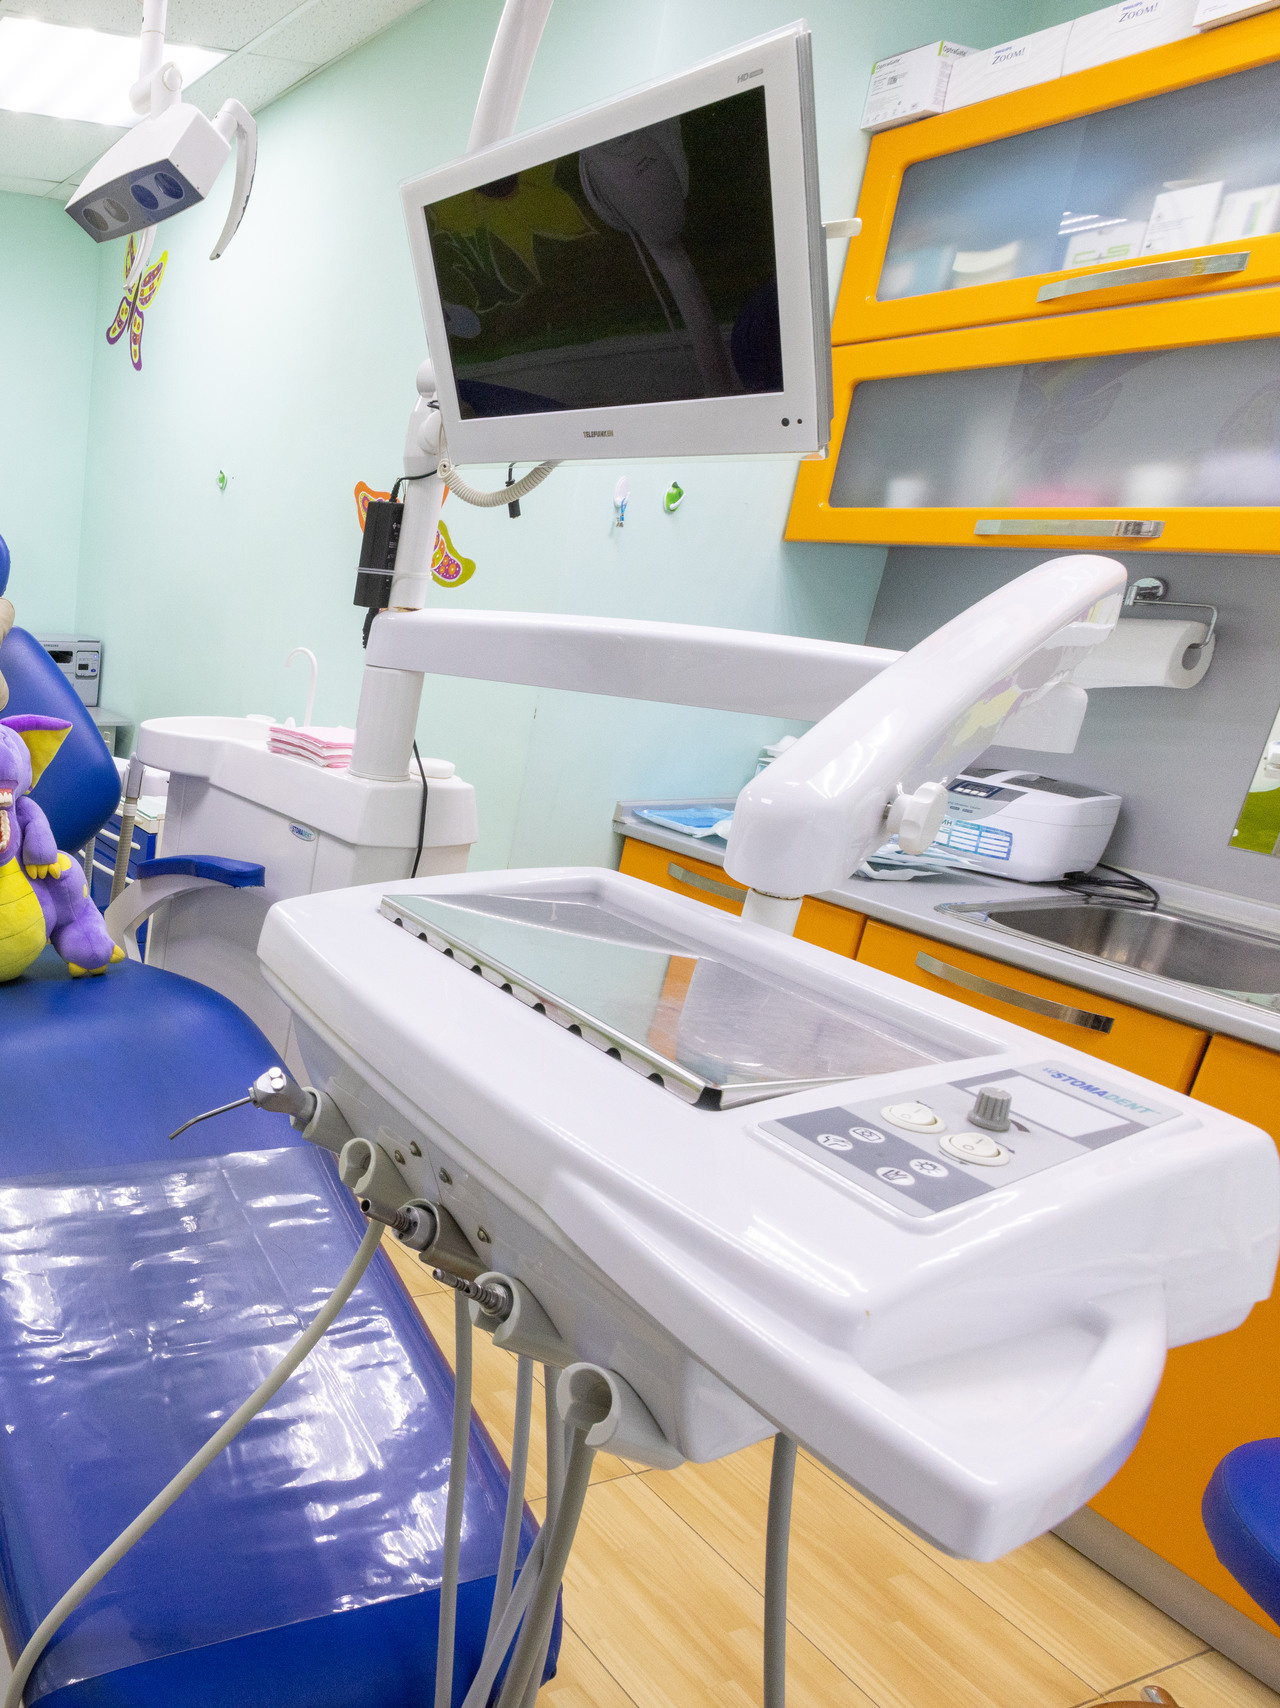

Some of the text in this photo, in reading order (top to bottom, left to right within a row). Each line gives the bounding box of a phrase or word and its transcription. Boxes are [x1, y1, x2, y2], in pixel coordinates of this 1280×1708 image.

[1119, 2, 1159, 23] ZOOM!
[992, 47, 1026, 65] ZOOM!
[737, 72, 749, 83] HD
[1051, 1072, 1155, 1114] STOMADENT
